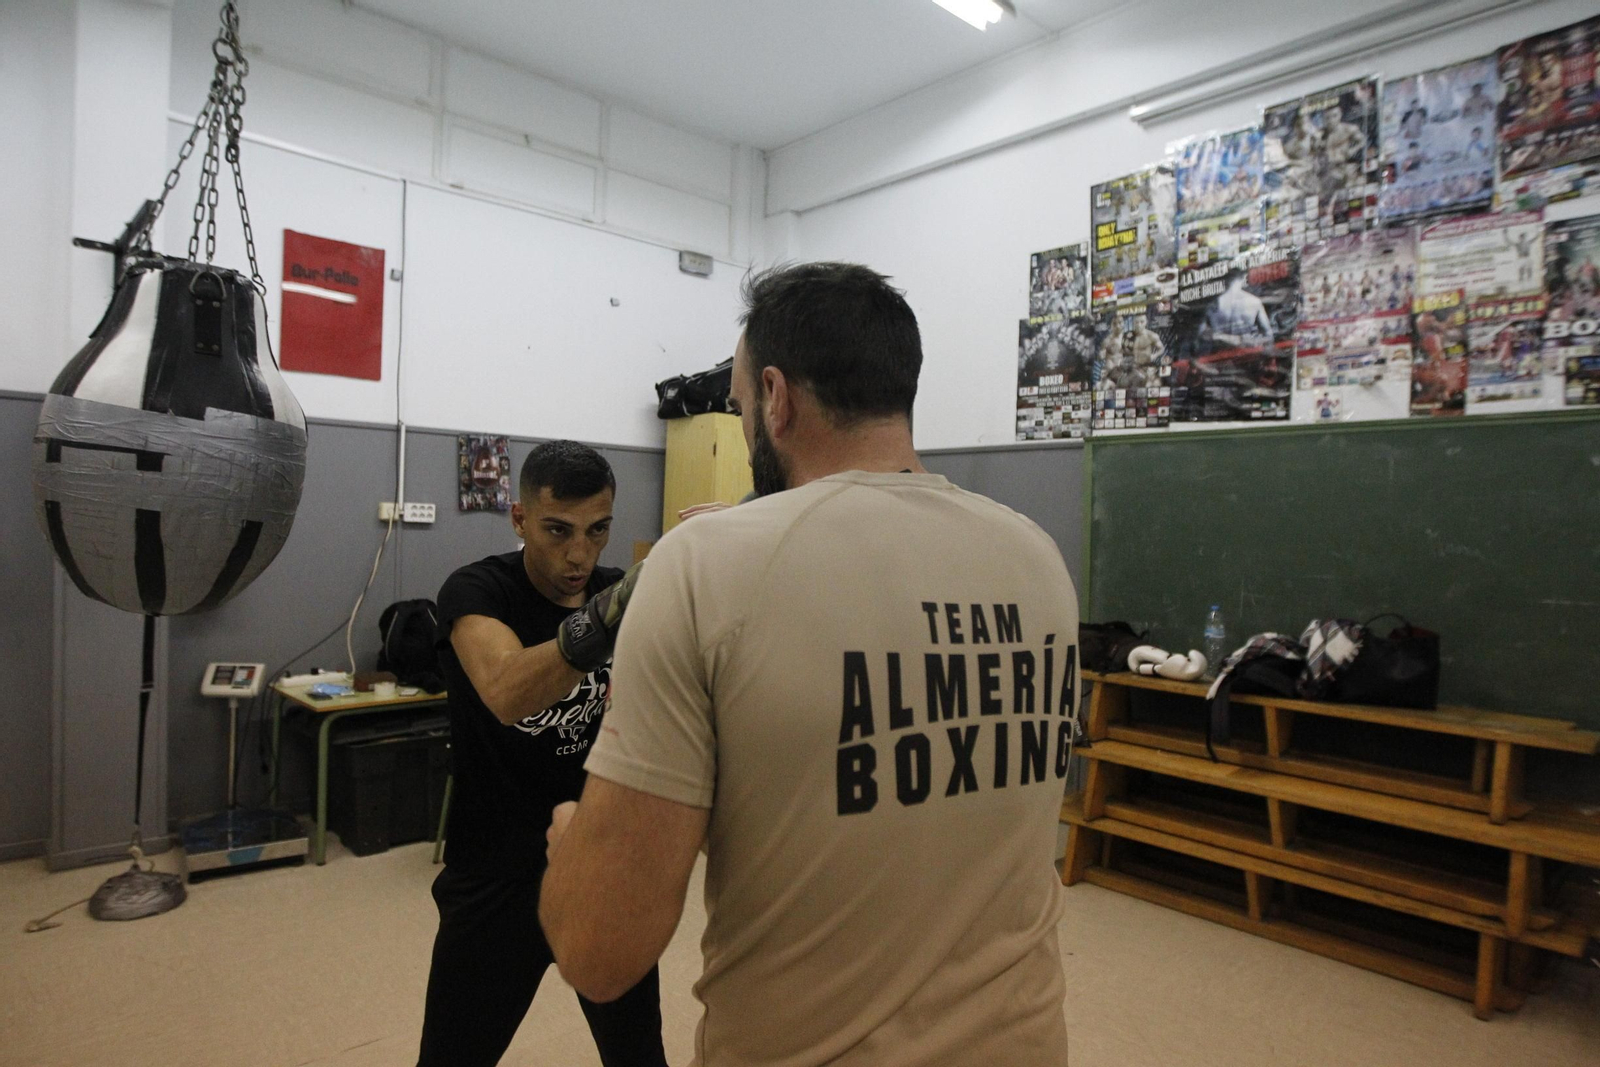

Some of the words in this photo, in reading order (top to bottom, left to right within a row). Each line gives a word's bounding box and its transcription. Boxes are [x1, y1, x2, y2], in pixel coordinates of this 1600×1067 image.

[1038, 373, 1065, 387] BOXEO
[921, 602, 1023, 644] TEAM
[838, 633, 1076, 745] ALMERÍA
[837, 720, 1072, 816] BOXING
